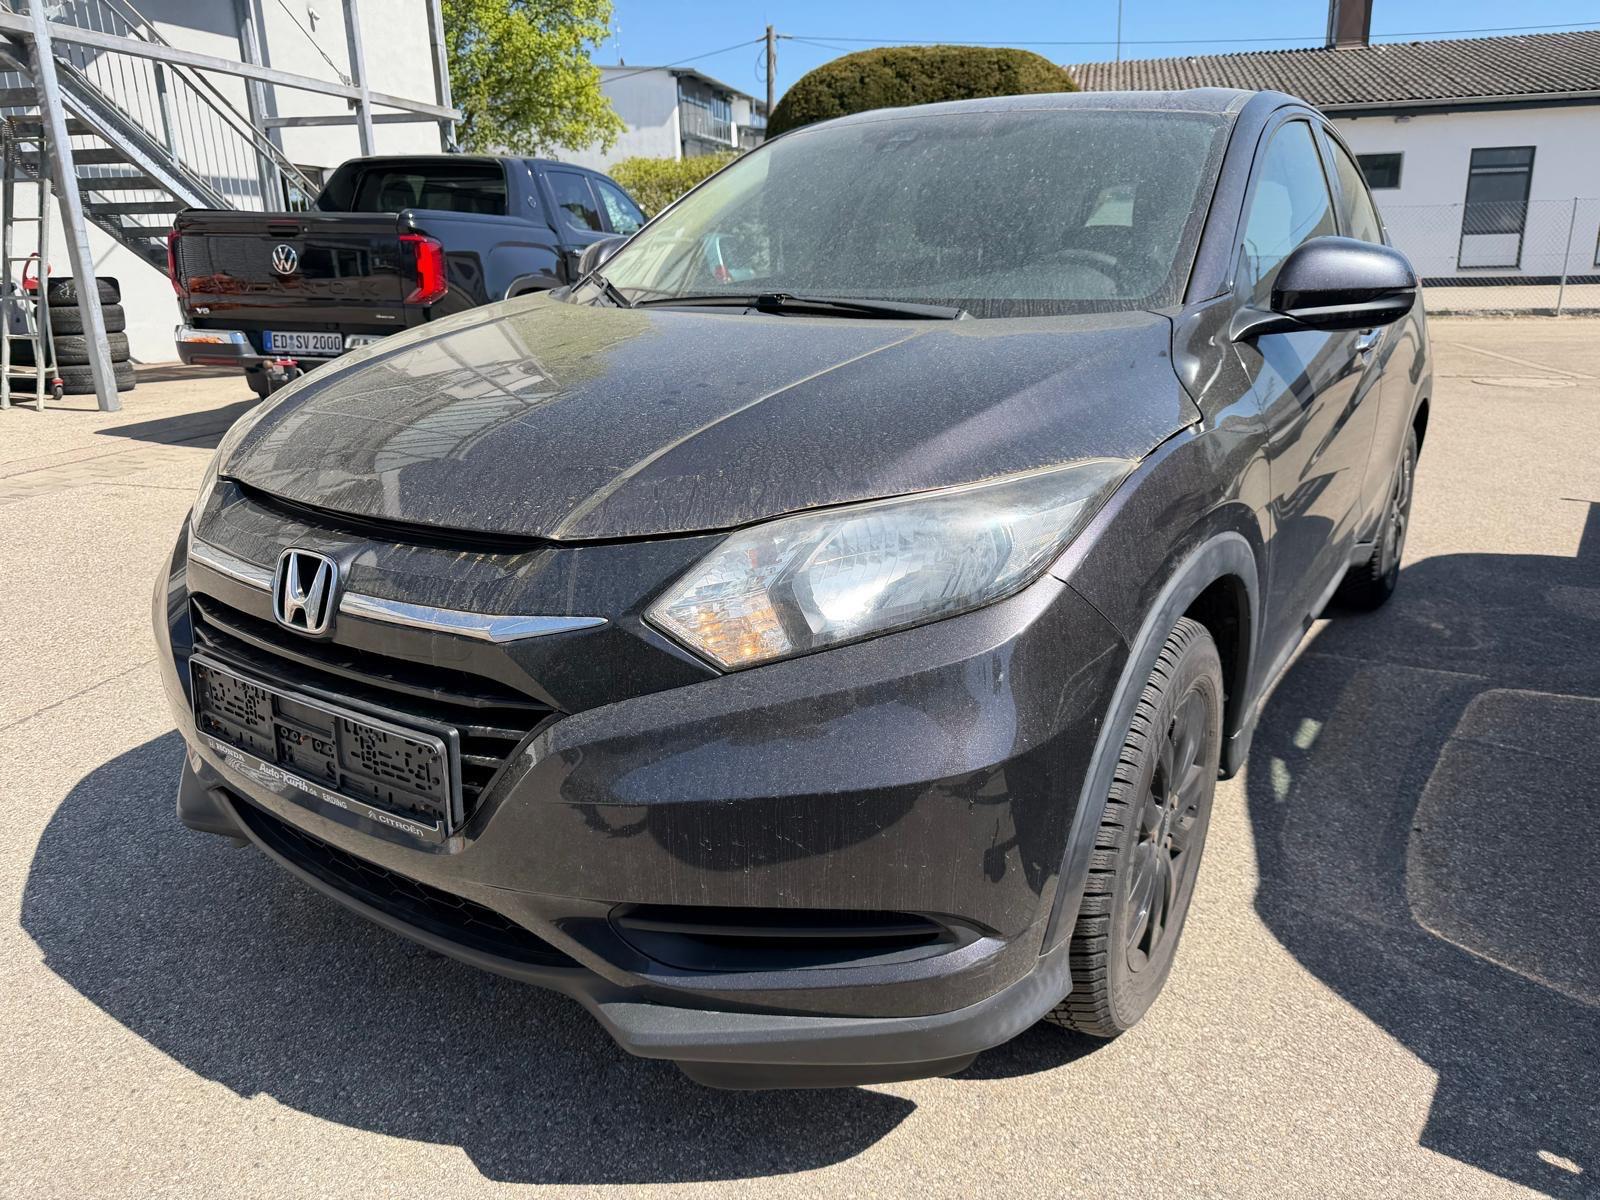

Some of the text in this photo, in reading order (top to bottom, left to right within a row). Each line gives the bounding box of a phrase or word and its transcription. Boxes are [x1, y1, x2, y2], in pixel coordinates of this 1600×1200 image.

[210, 277, 381, 297] AMAROK
[272, 334, 341, 350] ED SV 2000
[215, 742, 245, 762] HONDA
[322, 793, 348, 809] ERDING
